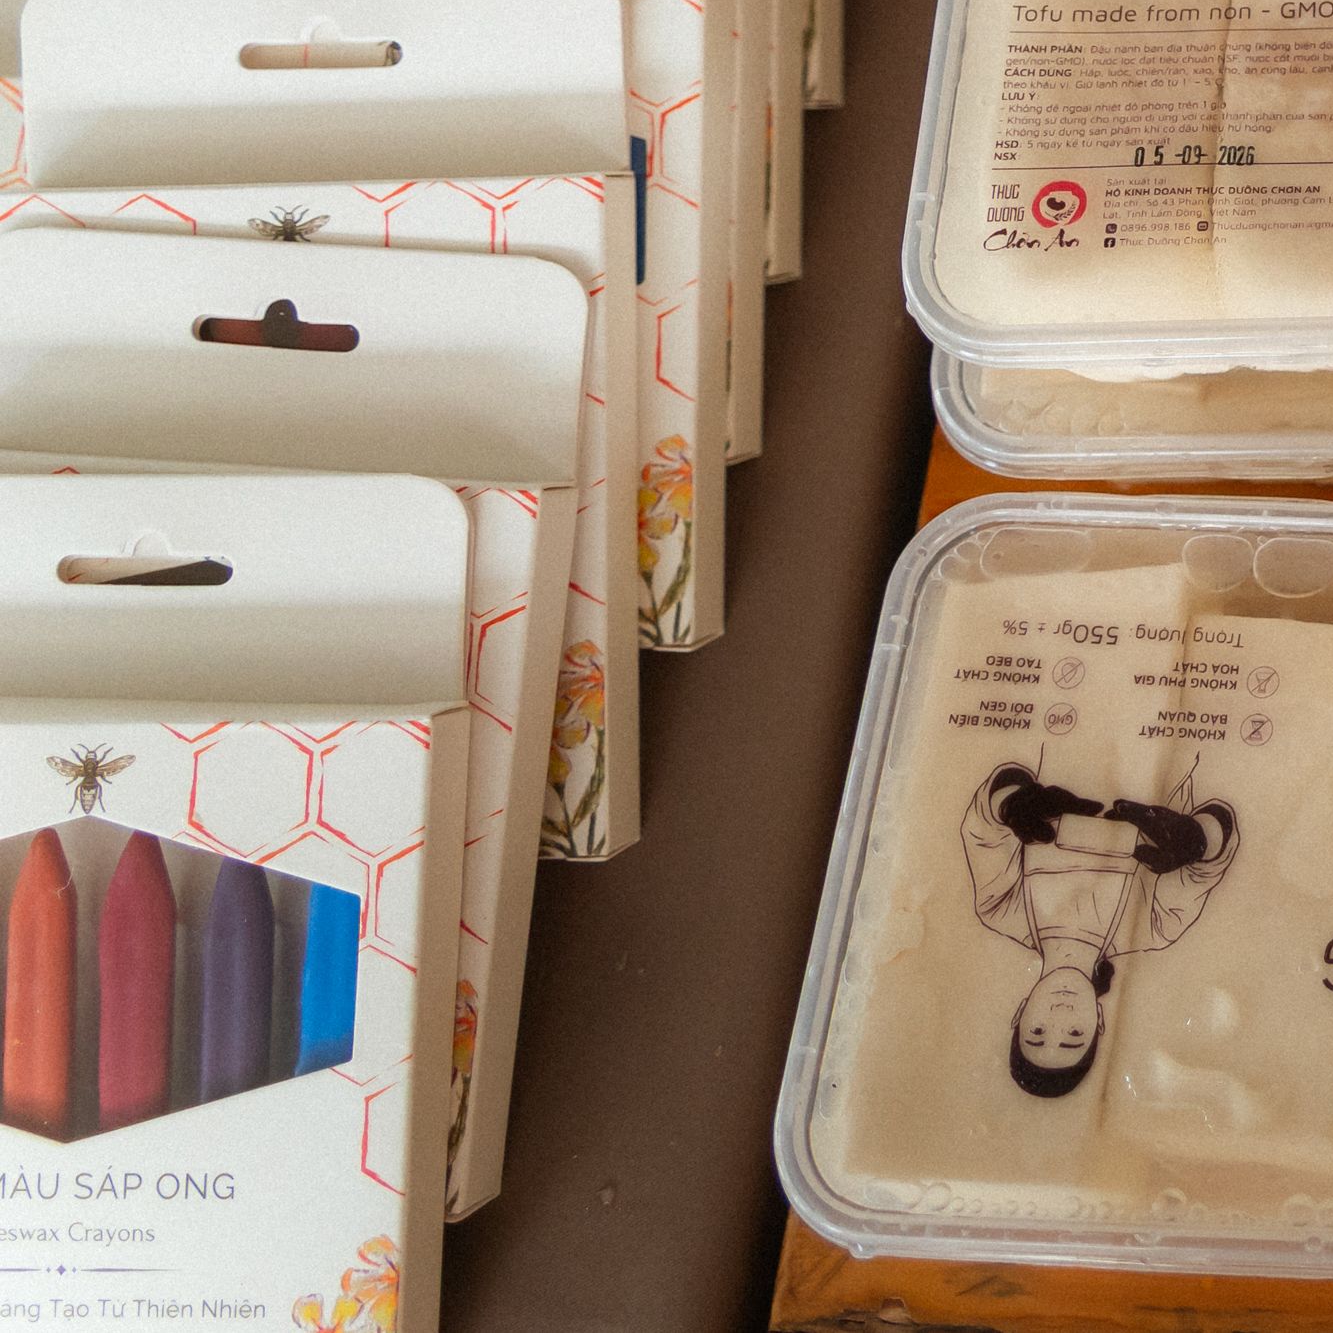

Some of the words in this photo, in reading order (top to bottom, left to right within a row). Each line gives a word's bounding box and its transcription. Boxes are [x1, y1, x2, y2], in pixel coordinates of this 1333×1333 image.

[1012, 4, 1064, 24] Tofu
[1072, 5, 1137, 23] made
[1146, 3, 1200, 22] from
[1209, 4, 1252, 21] non
[993, 151, 1021, 162] NSX:
[1218, 145, 1256, 166] 2026
[1001, 619, 1029, 637] 5%
[1052, 618, 1120, 647] 550gr
[1192, 628, 1245, 649] Trọng
[948, 713, 980, 730] BIẾN
[982, 716, 1032, 730] KHÔNG
[1138, 724, 1175, 741] CHẤT
[1178, 727, 1228, 742] KHÔNG
[73, 1164, 143, 1200] SÁP
[156, 1172, 236, 1200] ONG
[0, 1224, 60, 1243] eswax
[68, 1221, 156, 1247] Crayons
[0, 1300, 41, 1323] áng
[50, 1298, 90, 1322] Tạo
[133, 1298, 193, 1318] Thiên
[202, 1298, 267, 1318] Nhiên
